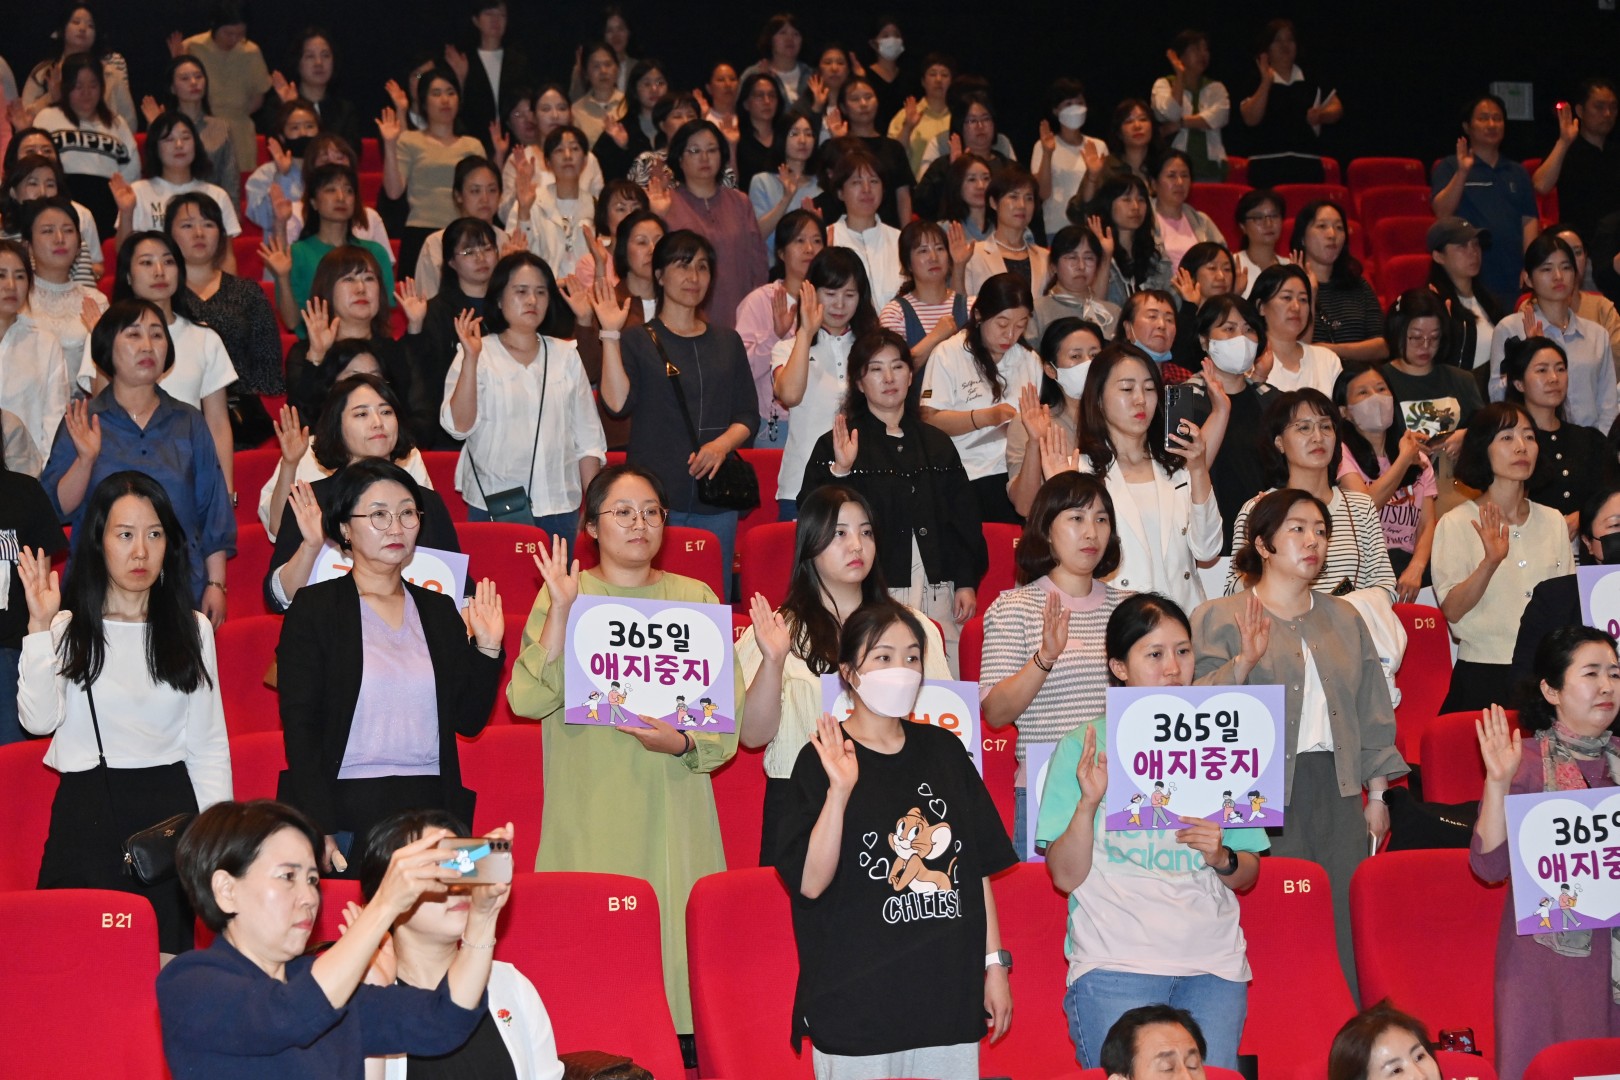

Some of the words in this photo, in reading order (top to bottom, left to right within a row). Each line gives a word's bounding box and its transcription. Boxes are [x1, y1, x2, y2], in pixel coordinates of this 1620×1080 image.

[608, 620, 690, 653] 365일
[590, 652, 710, 687] 애지중지
[1153, 710, 1239, 743] 365일
[1133, 747, 1259, 781] 애지중지
[882, 888, 962, 924] CHEES
